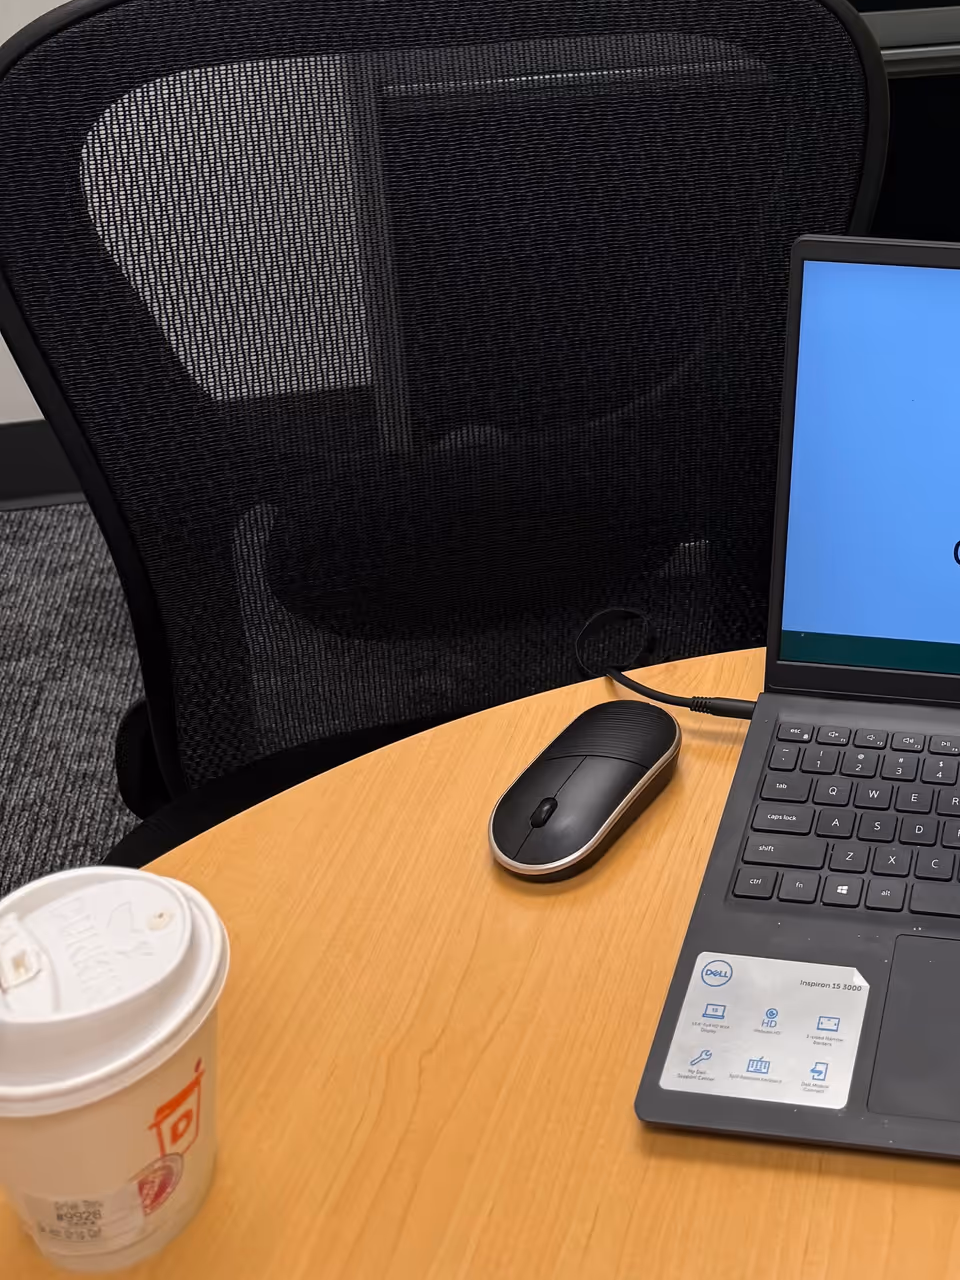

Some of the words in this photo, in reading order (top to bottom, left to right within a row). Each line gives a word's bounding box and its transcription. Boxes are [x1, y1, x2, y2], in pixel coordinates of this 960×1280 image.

[828, 786, 838, 796] Q
[868, 789, 880, 799] W
[910, 793, 919, 802] E
[951, 797, 960, 806] R
[767, 813, 782, 821] caps
[831, 818, 840, 827] A
[873, 821, 881, 831] S
[915, 824, 924, 834] D
[758, 844, 774, 852] shift
[845, 851, 854, 861] Z
[887, 855, 896, 865] X
[931, 859, 939, 869] C
[881, 889, 891, 897] alt
[705, 969, 729, 978] DELL
[800, 980, 831, 989] Inspiron
[842, 984, 862, 992] 3000
[761, 1019, 778, 1029] HD
